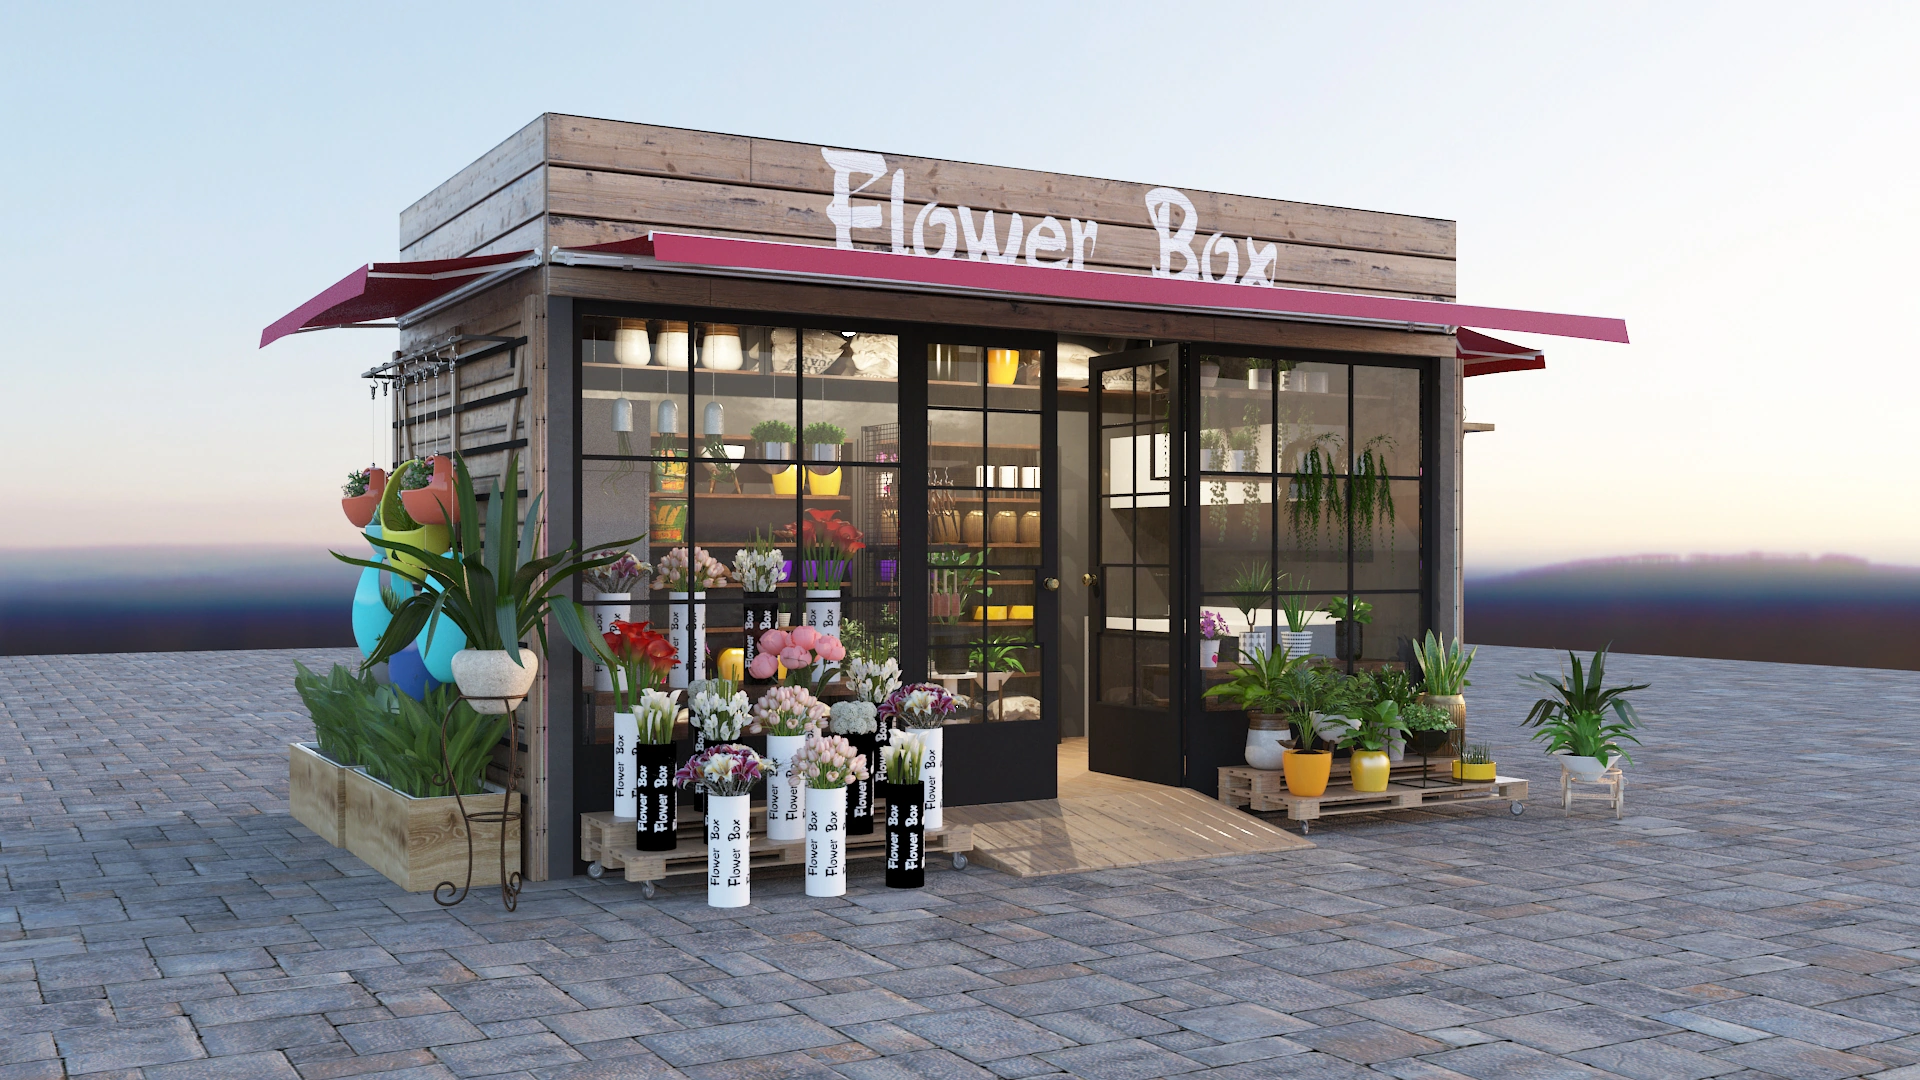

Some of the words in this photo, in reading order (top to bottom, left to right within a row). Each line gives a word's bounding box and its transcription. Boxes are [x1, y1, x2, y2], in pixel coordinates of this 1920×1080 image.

[821, 147, 1098, 270] Flower
[1144, 187, 1278, 288] Box
[671, 612, 679, 631] Box
[745, 610, 754, 630] Box
[760, 610, 772, 630] Box
[808, 609, 816, 627] Box
[823, 609, 834, 627] Box
[695, 731, 705, 752] Box
[875, 722, 887, 742] Box
[616, 735, 625, 755] Box
[925, 749, 936, 769] Box
[616, 762, 625, 798] Flower
[638, 765, 648, 787] Box
[654, 765, 668, 788] Box
[769, 784, 778, 820] Flower
[925, 775, 936, 811] Flower
[638, 793, 648, 832] Flower
[654, 793, 668, 833] Flower
[808, 811, 818, 832] Box
[826, 811, 838, 833] Box
[888, 804, 899, 826] Box
[905, 804, 918, 827] Box
[711, 819, 720, 841] Box
[728, 819, 741, 842] Box
[808, 839, 818, 876] Flower
[826, 839, 838, 877] Flower
[888, 832, 899, 870] Flower
[905, 832, 918, 871] Flower
[711, 848, 720, 887] Flower
[728, 848, 741, 888] Flower
